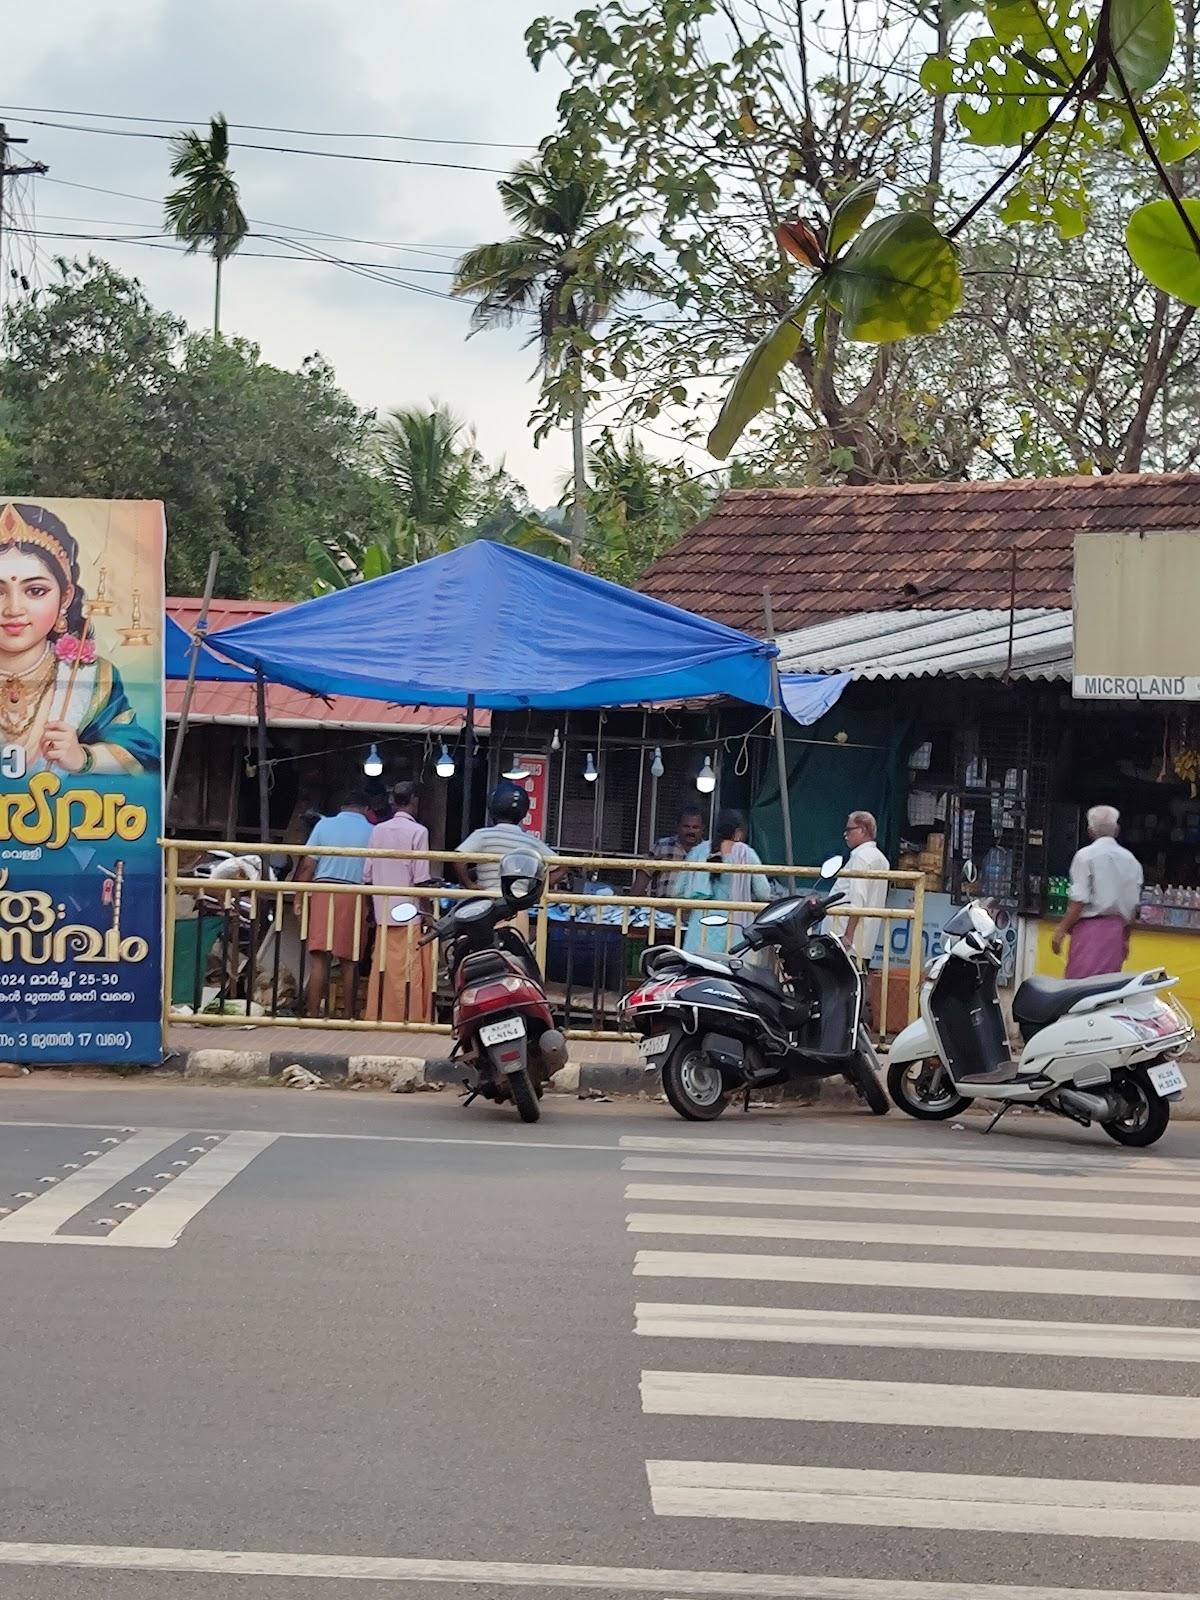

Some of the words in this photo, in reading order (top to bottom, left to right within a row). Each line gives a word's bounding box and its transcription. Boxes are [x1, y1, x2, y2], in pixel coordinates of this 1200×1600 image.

[1085, 677, 1185, 695] MICROLAND
[0, 973, 25, 985] 024
[79, 974, 118, 985] 25-30
[24, 989, 66, 1005] മുതൽ
[69, 989, 97, 1001] ശനി
[18, 1033, 28, 1047] 3
[31, 1031, 74, 1049] മുതൽ
[77, 1032, 92, 1046] 17
[95, 1030, 132, 1050] വരെ)
